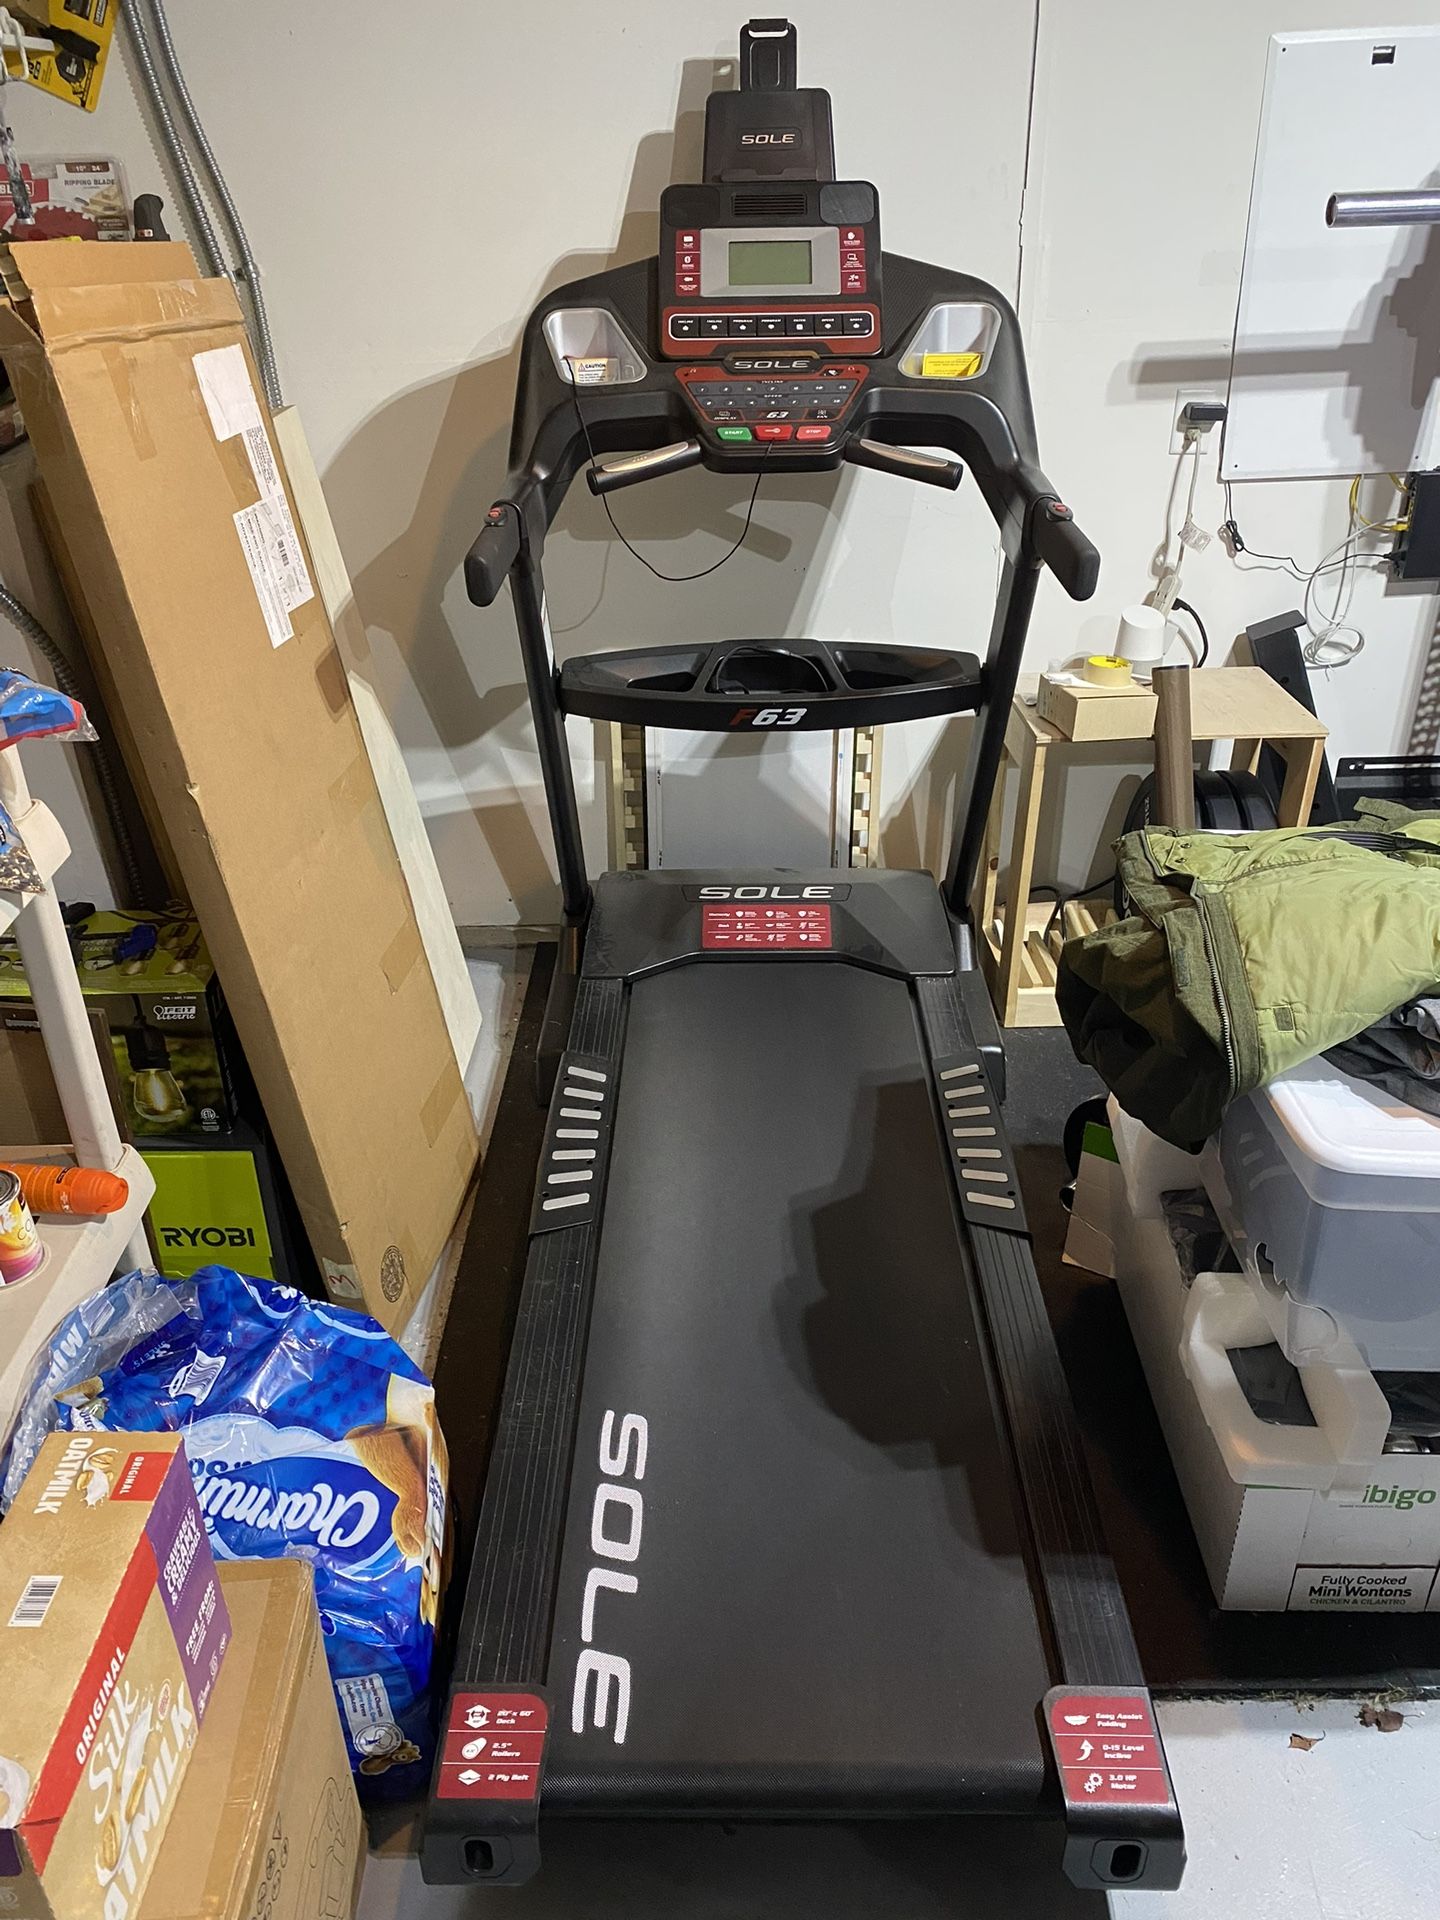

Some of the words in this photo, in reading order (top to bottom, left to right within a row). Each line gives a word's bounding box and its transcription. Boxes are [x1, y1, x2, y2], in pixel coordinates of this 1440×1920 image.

[741, 134, 795, 145] SOLE
[93, 178, 115, 186] BLADE
[734, 360, 810, 369] SOLE
[728, 707, 808, 726] F63
[698, 886, 834, 899] SOLE
[164, 1006, 196, 1014] FEIT
[160, 1227, 255, 1247] RYOBI
[33, 1437, 94, 1514] OATMILK
[119, 1456, 144, 1495] ORIGINAL
[167, 1518, 198, 1594] CREAMY
[177, 1528, 201, 1592] DELICIOUS
[571, 1409, 648, 1745] SOLE
[1321, 1575, 1355, 1587] Fully
[1356, 1576, 1408, 1585] Cooked
[1308, 1586, 1342, 1597] Mini
[1345, 1585, 1412, 1597] Wontons
[185, 1619, 200, 1657] FREE
[75, 1646, 126, 1765] ORIGINAL
[1097, 1721, 1127, 1729] Folding
[88, 1680, 139, 1825] Silk
[496, 1774, 510, 1782] Ply
